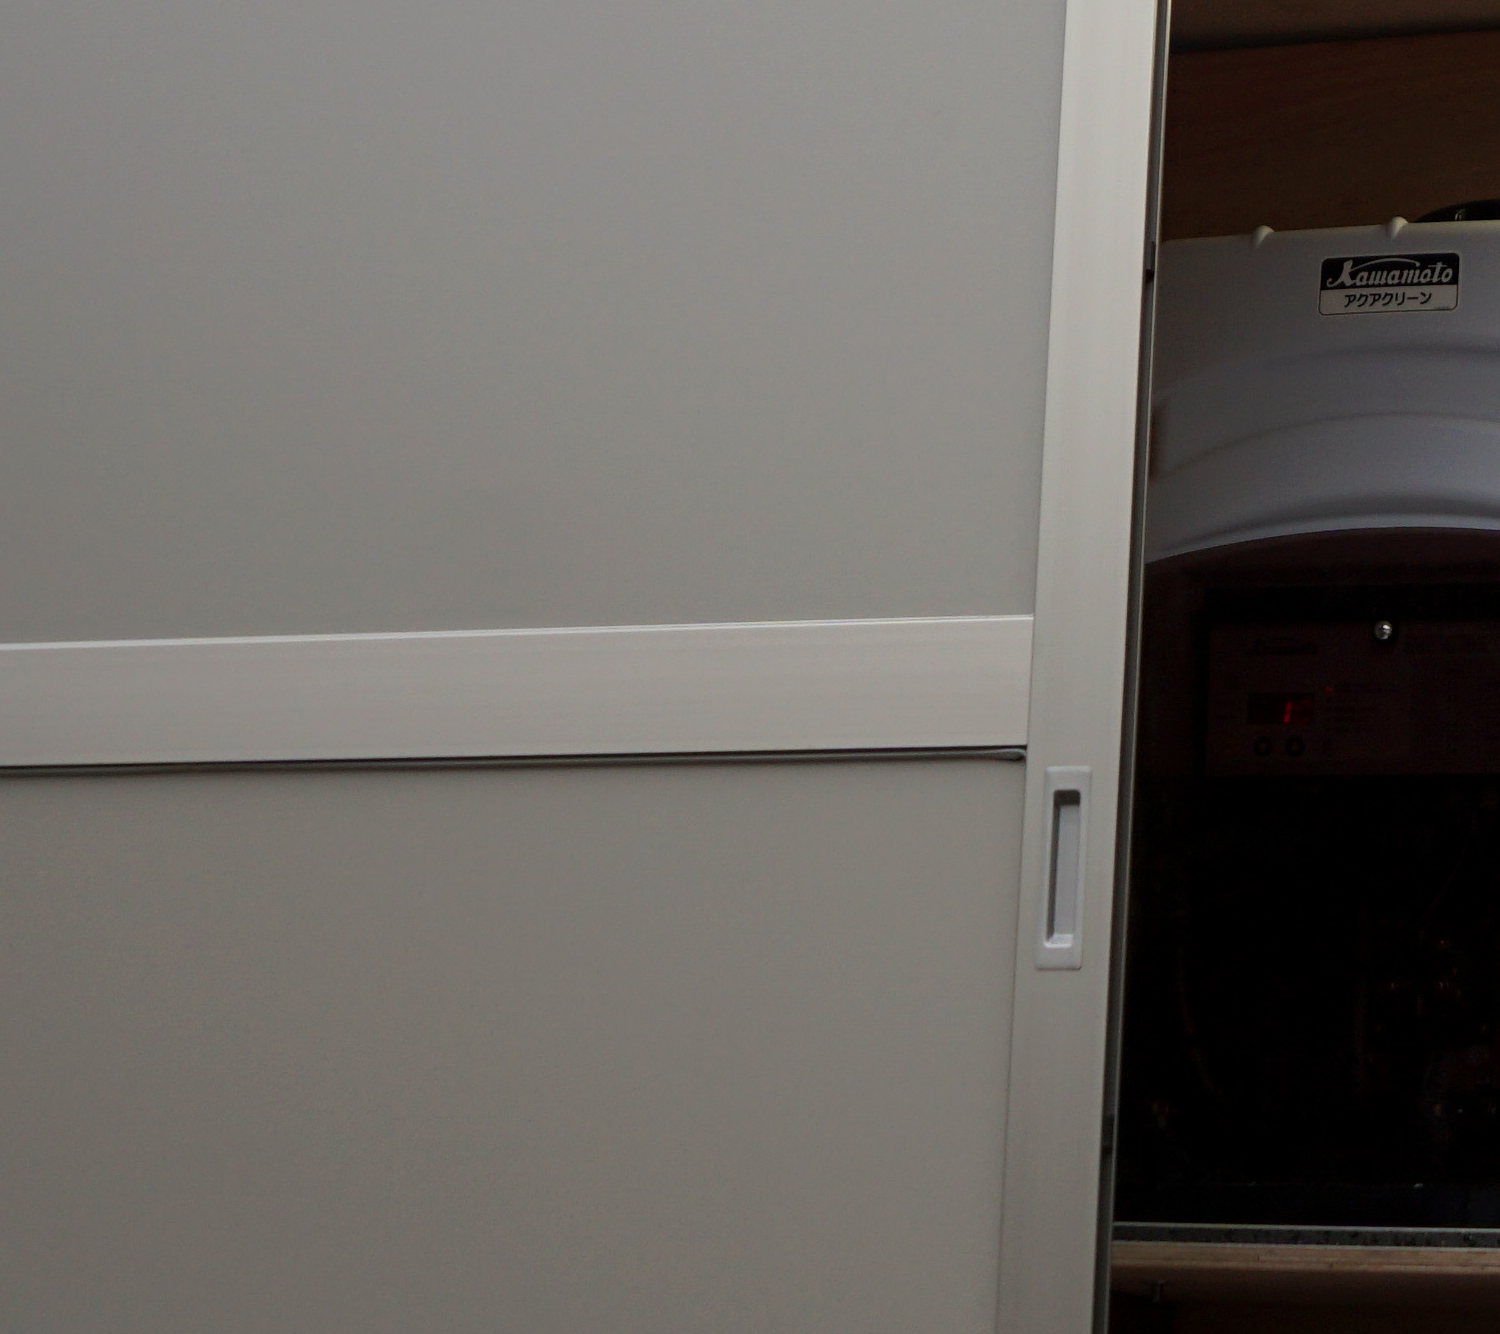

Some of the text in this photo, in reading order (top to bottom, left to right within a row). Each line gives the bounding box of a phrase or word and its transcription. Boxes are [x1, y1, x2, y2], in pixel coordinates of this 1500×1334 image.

[1326, 258, 1453, 287] Kawamoto
[1344, 292, 1432, 308] アクアクリーン
